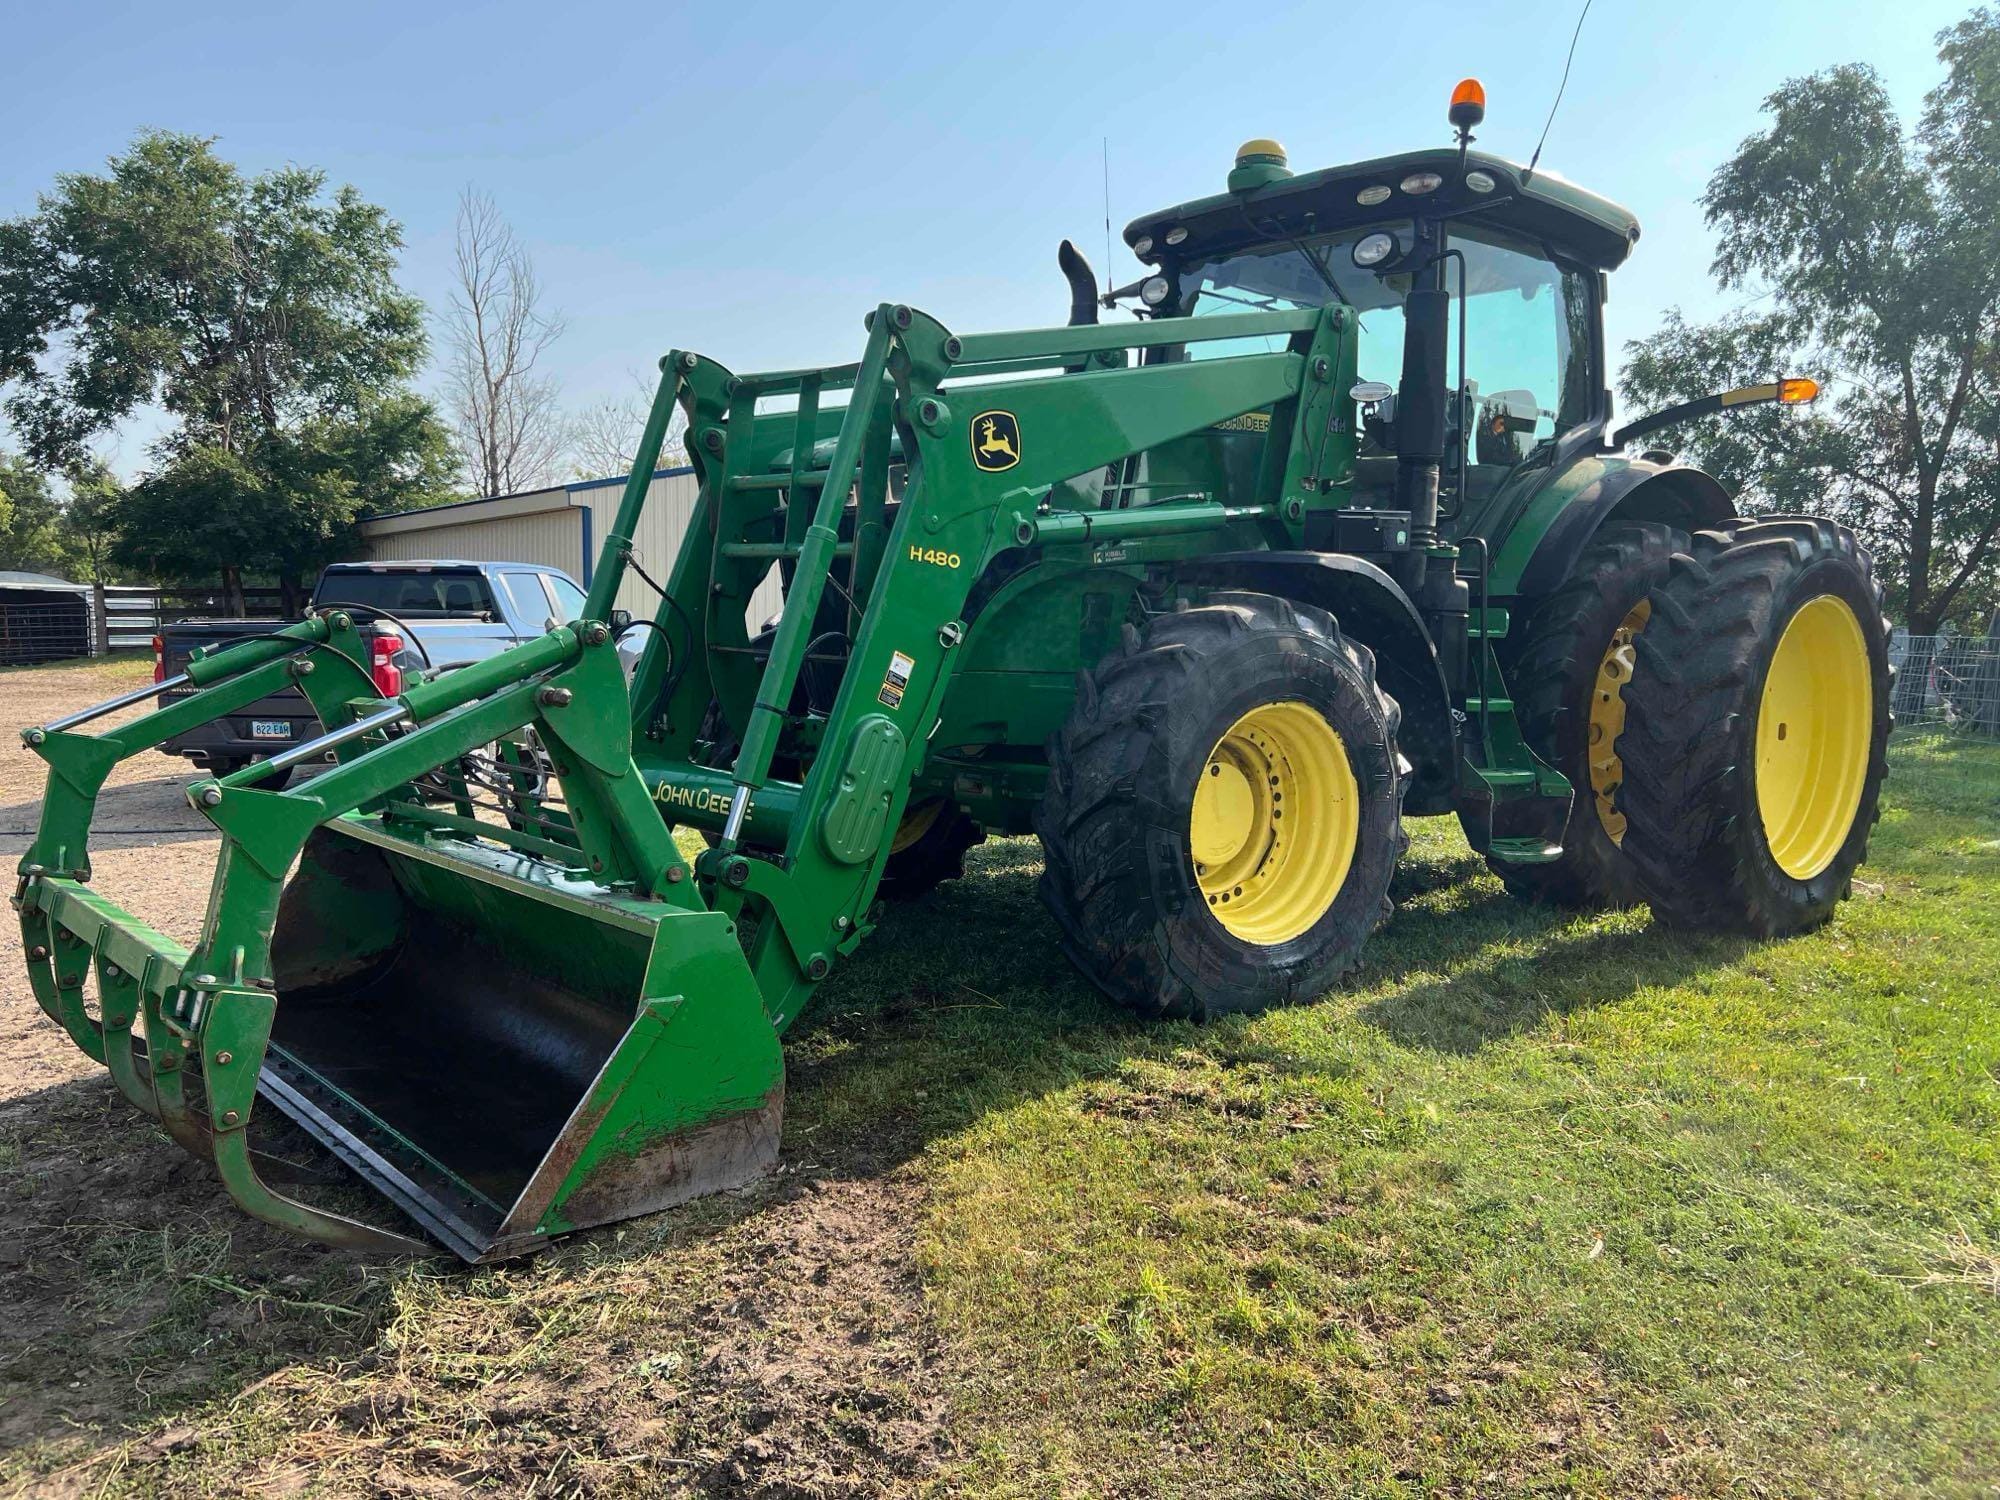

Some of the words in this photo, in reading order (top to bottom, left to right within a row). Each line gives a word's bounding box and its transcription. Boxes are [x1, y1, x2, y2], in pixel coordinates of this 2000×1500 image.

[910, 545, 961, 569] H480
[256, 724, 272, 735] 822
[652, 780, 695, 807] JOHN
[696, 788, 755, 821] DEEE
